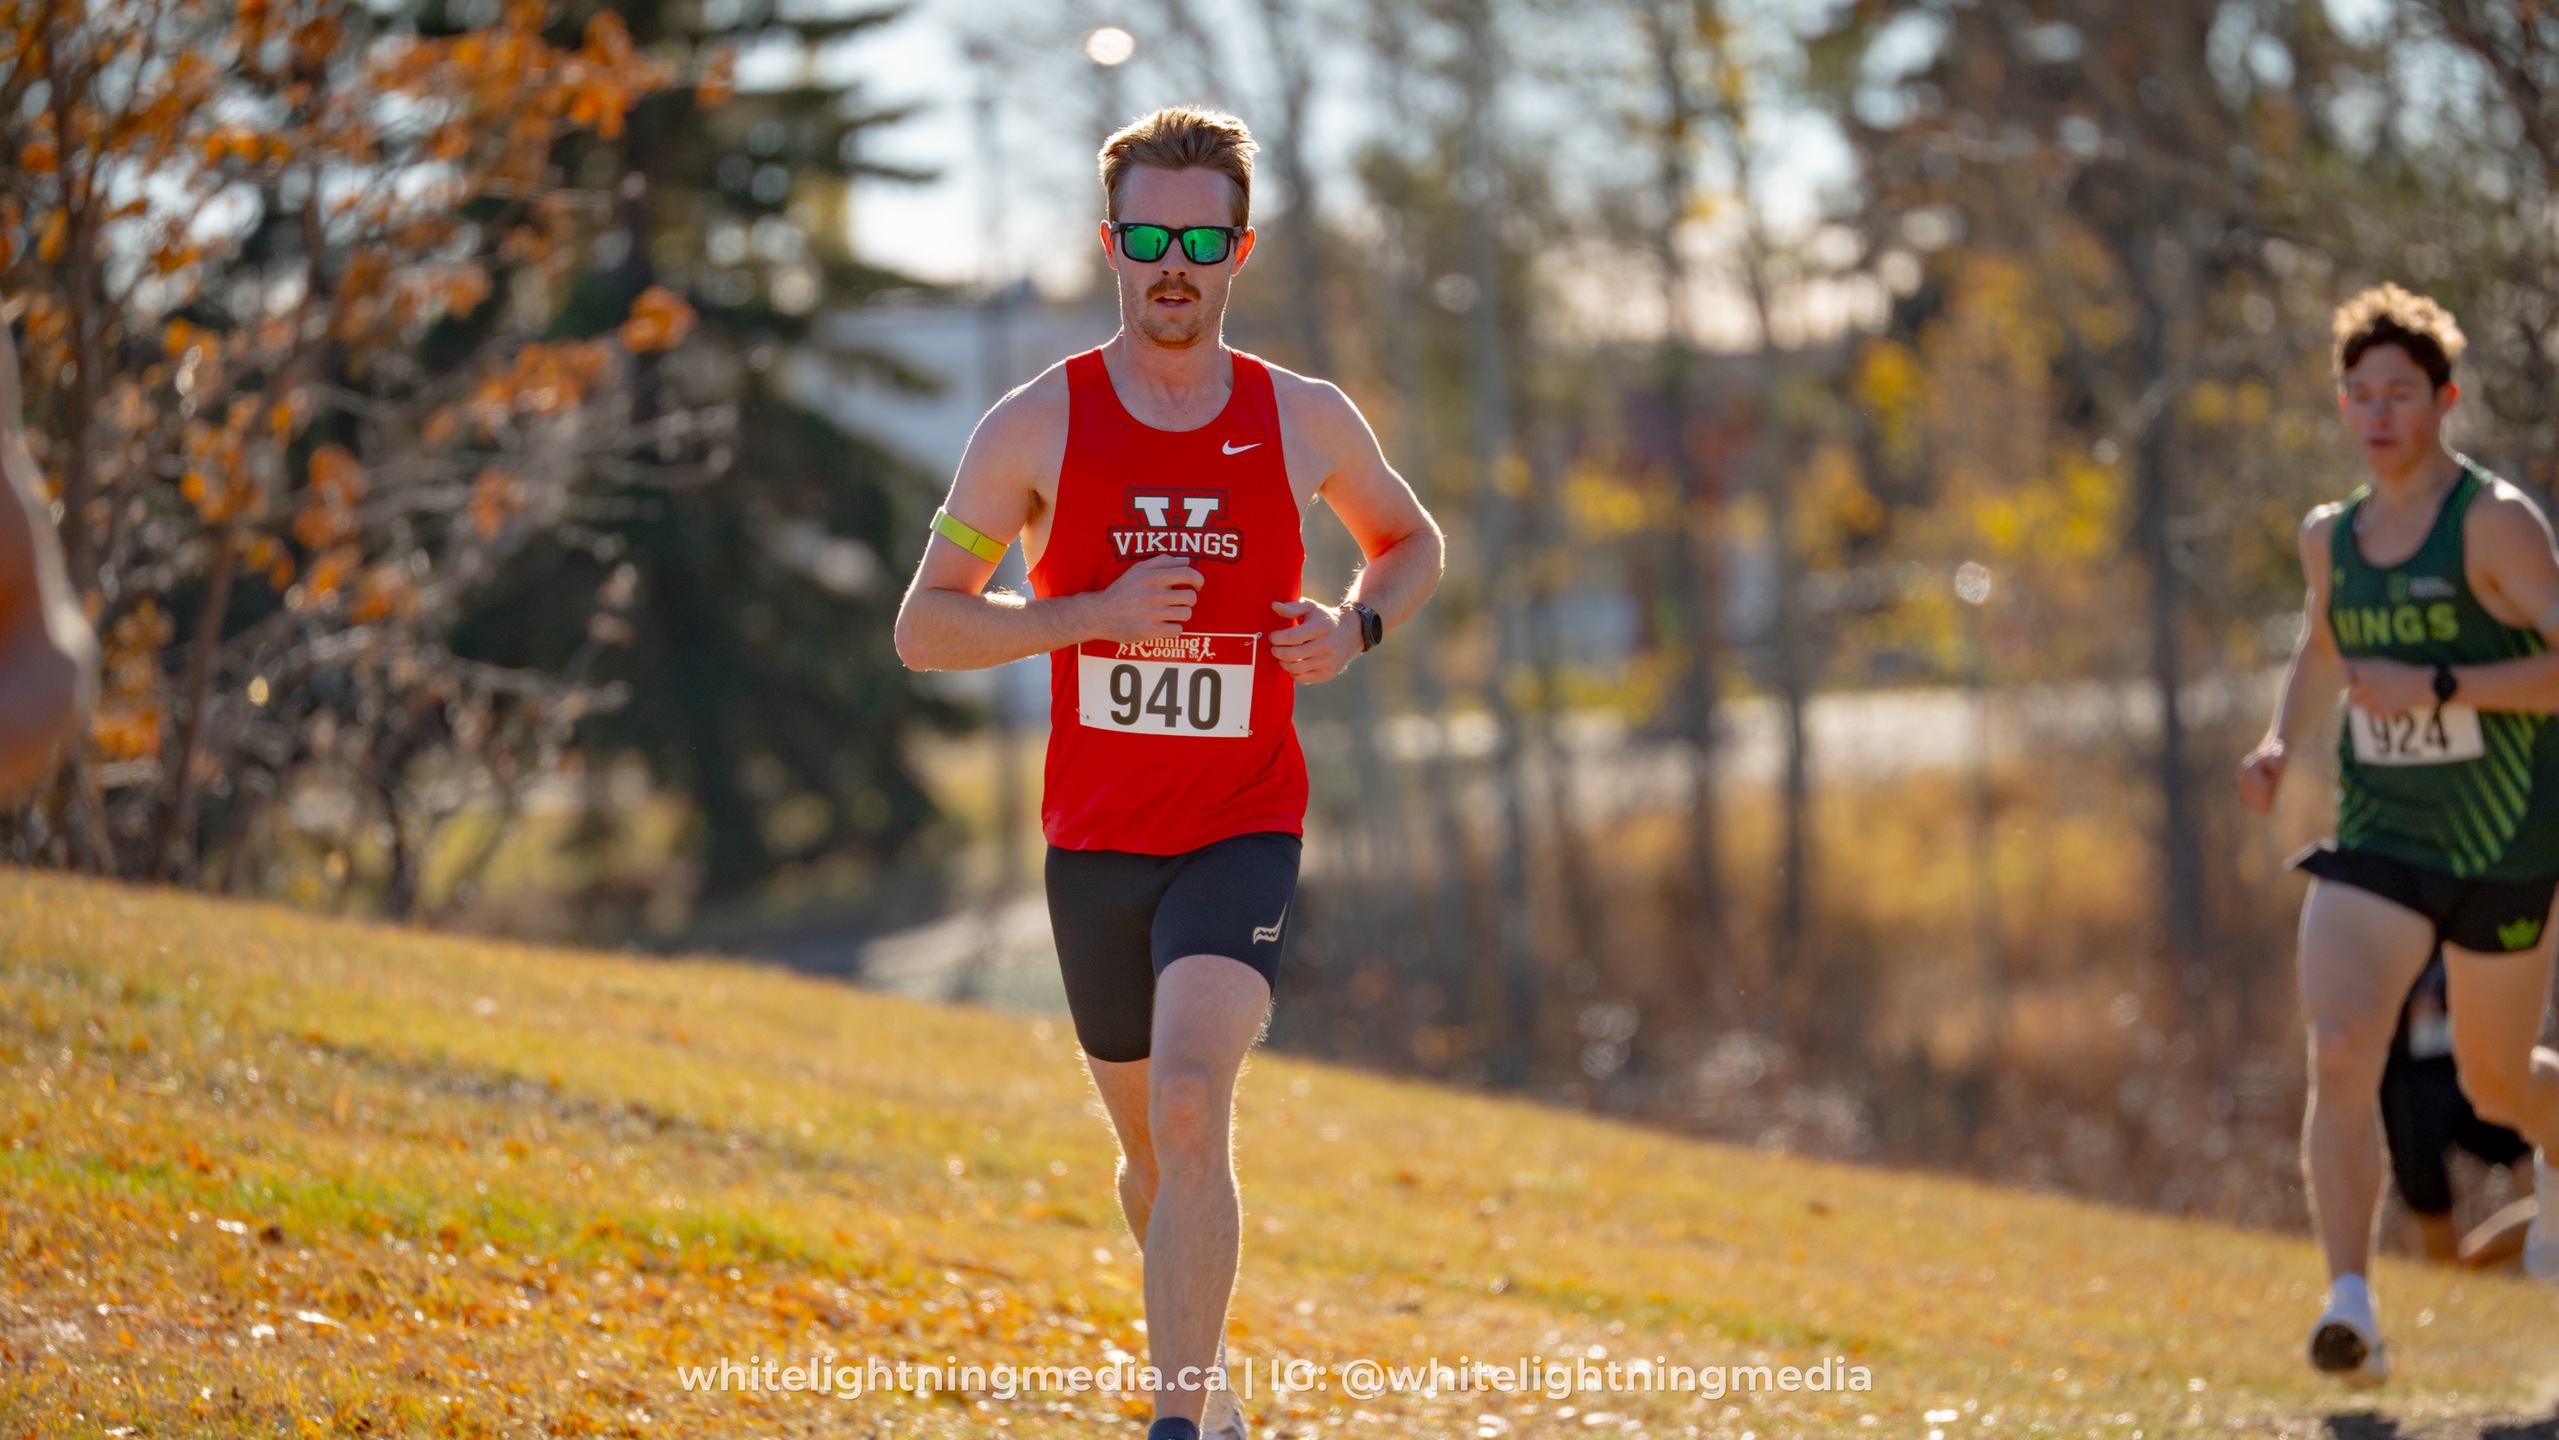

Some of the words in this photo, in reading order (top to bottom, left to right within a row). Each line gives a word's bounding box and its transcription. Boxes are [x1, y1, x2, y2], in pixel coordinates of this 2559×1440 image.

[1112, 531, 1239, 559] VIKINGS
[1109, 664, 1222, 730] 940
[2368, 704, 2449, 754] 924
